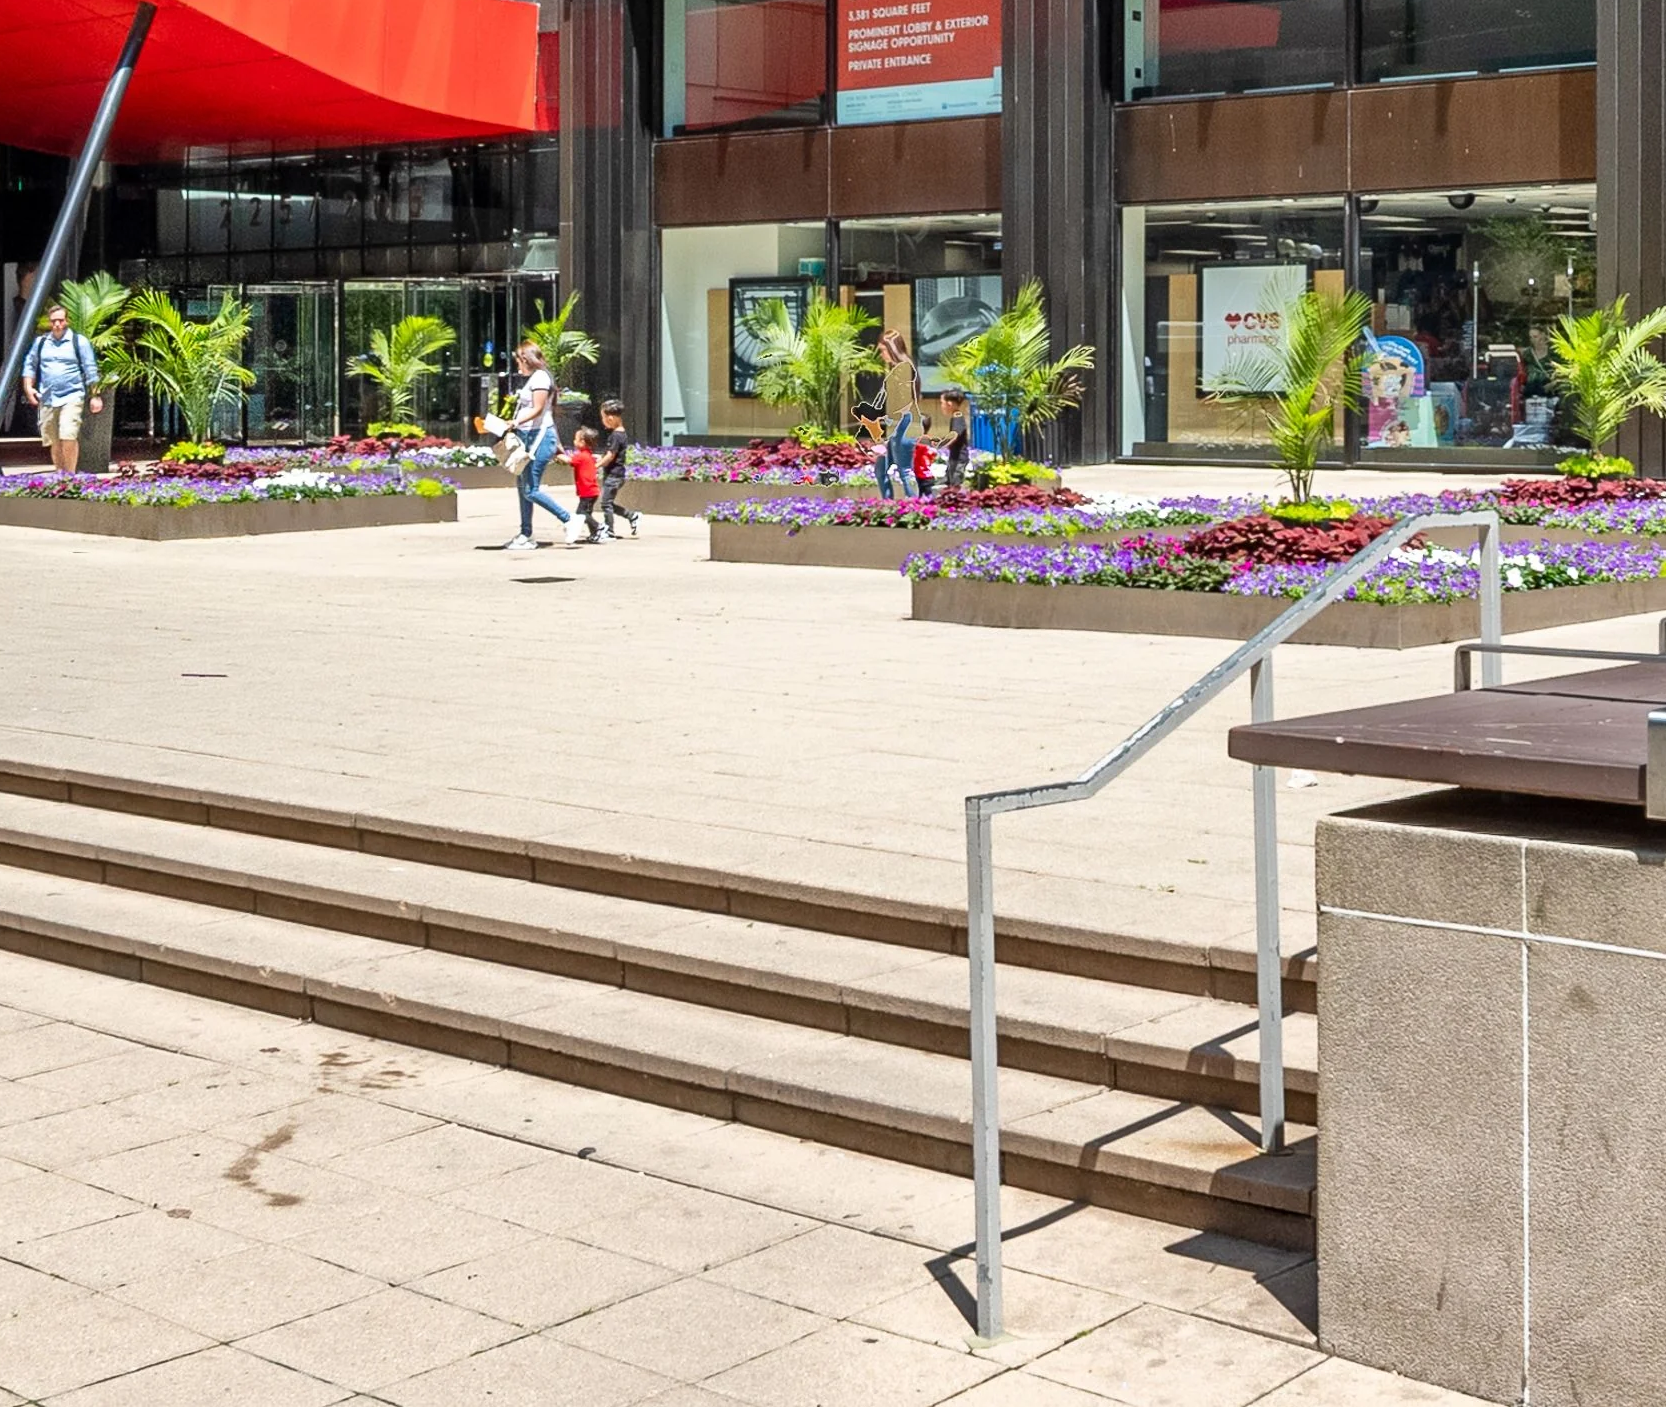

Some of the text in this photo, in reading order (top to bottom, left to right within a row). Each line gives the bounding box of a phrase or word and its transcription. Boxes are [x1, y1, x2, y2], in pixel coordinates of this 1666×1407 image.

[872, 5, 909, 19] SQUARE
[911, 2, 932, 14] FEET
[848, 15, 989, 40] PROMINENT LOBBY & EXTERIOR
[848, 32, 955, 53] SIGNAGE OPPORTUNITY
[848, 53, 932, 72] PRIVATE ENTRANCE
[1243, 312, 1280, 330] CVS
